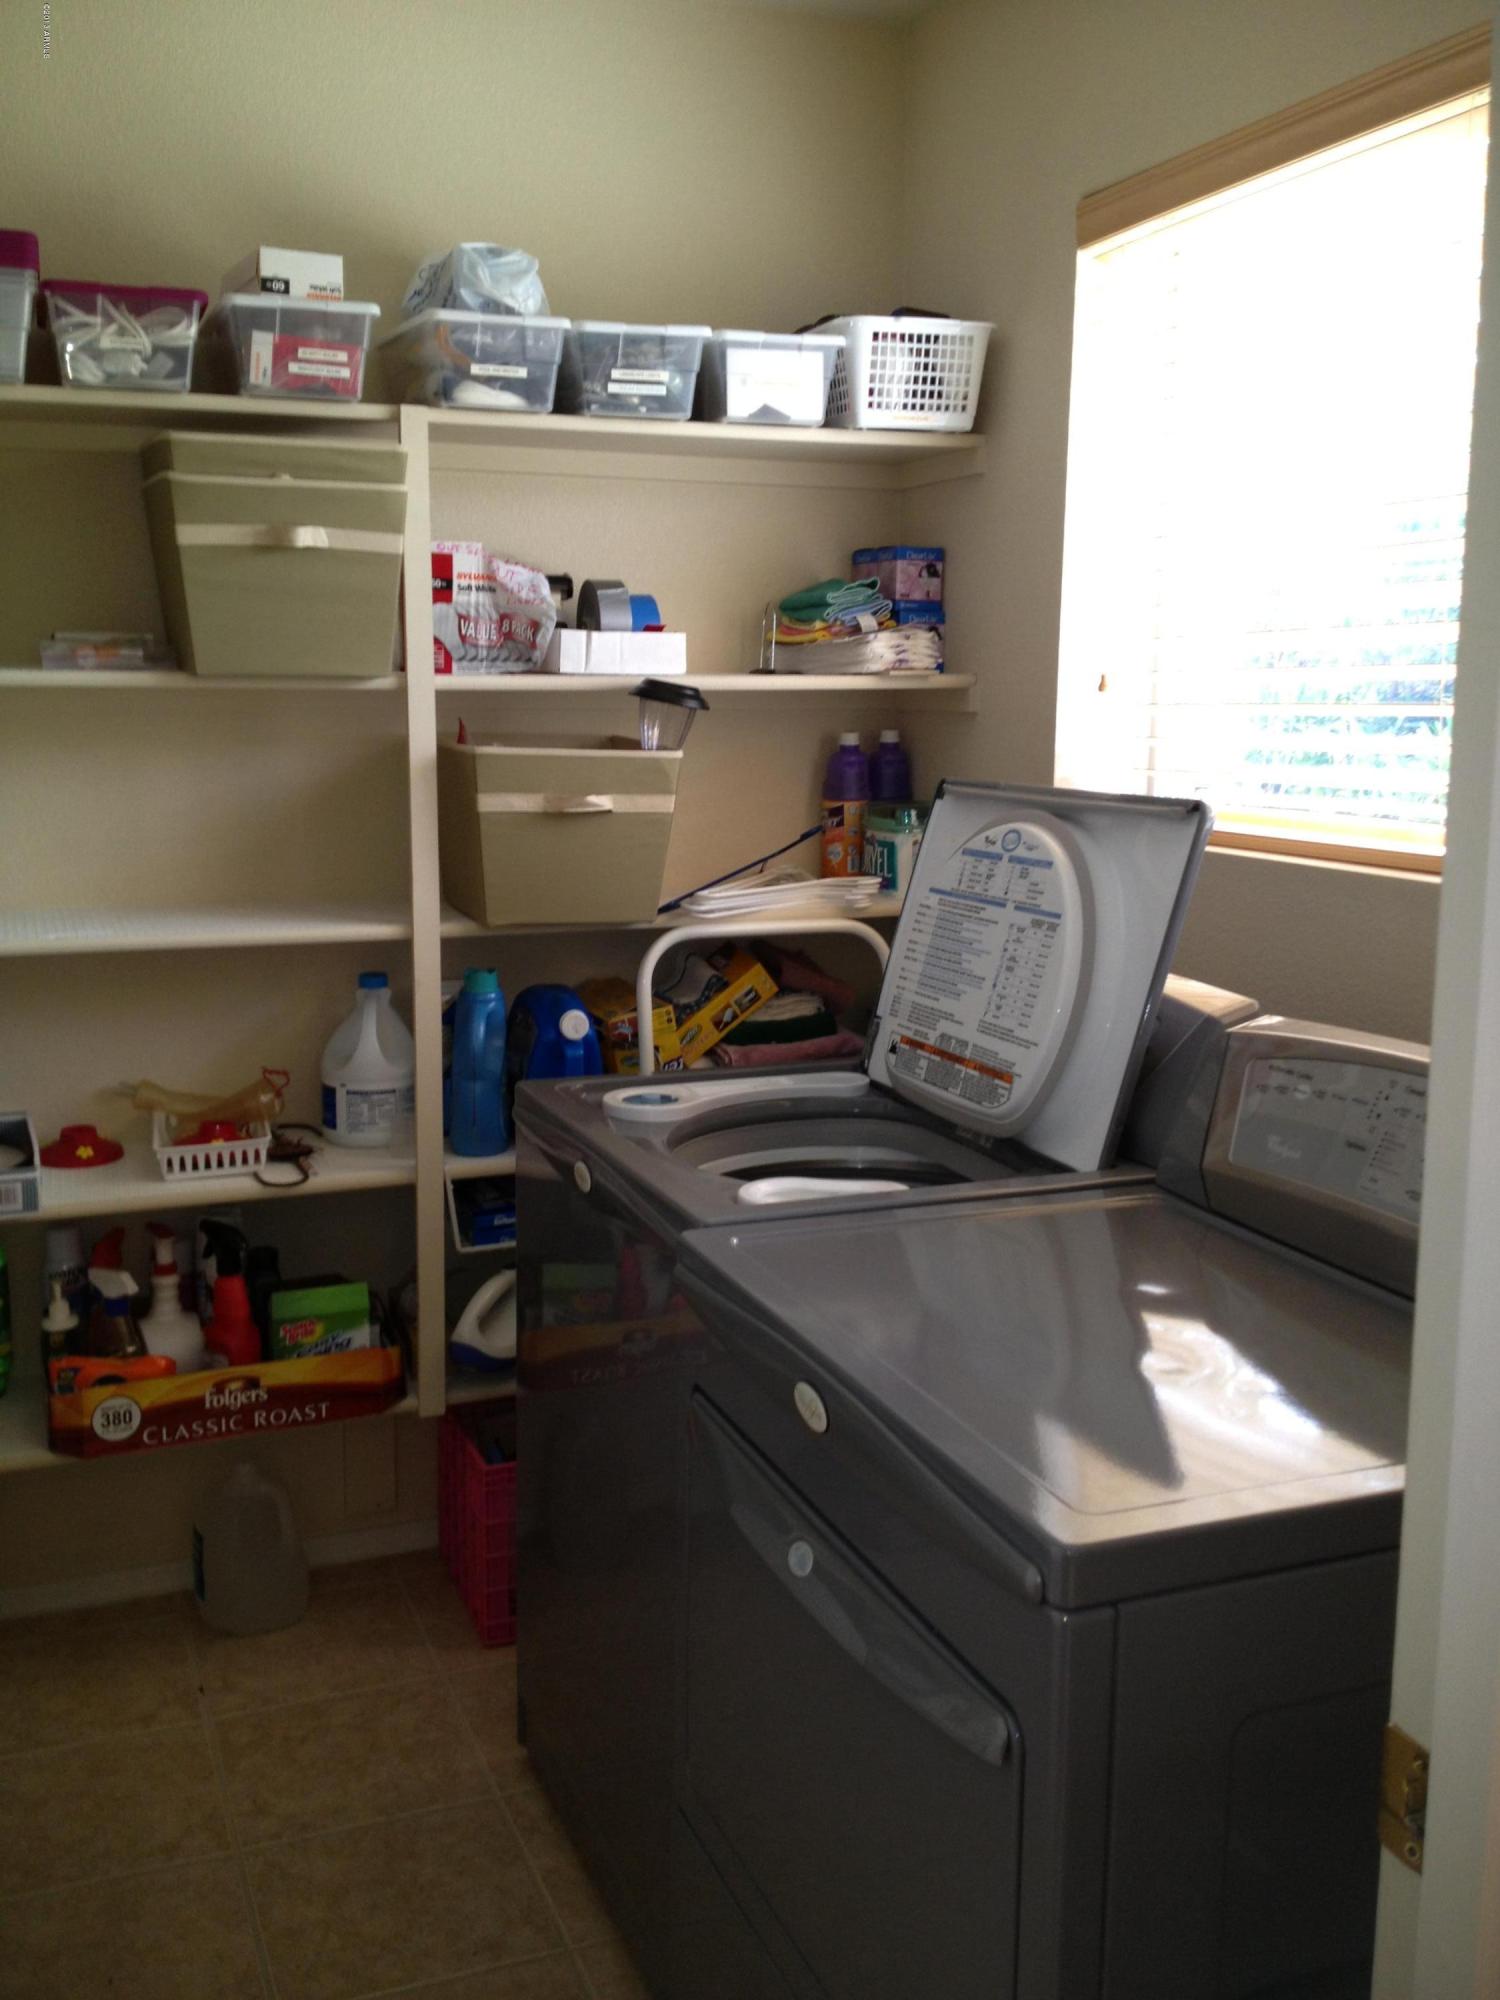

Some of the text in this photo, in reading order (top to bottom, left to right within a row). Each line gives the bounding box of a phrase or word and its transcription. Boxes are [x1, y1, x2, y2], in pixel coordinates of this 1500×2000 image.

[461, 619, 496, 640] VALUE
[511, 622, 534, 641] PACK
[204, 1386, 268, 1410] Folgers
[101, 1409, 133, 1429] 380
[142, 1402, 330, 1445] CLASSIC ROAST
